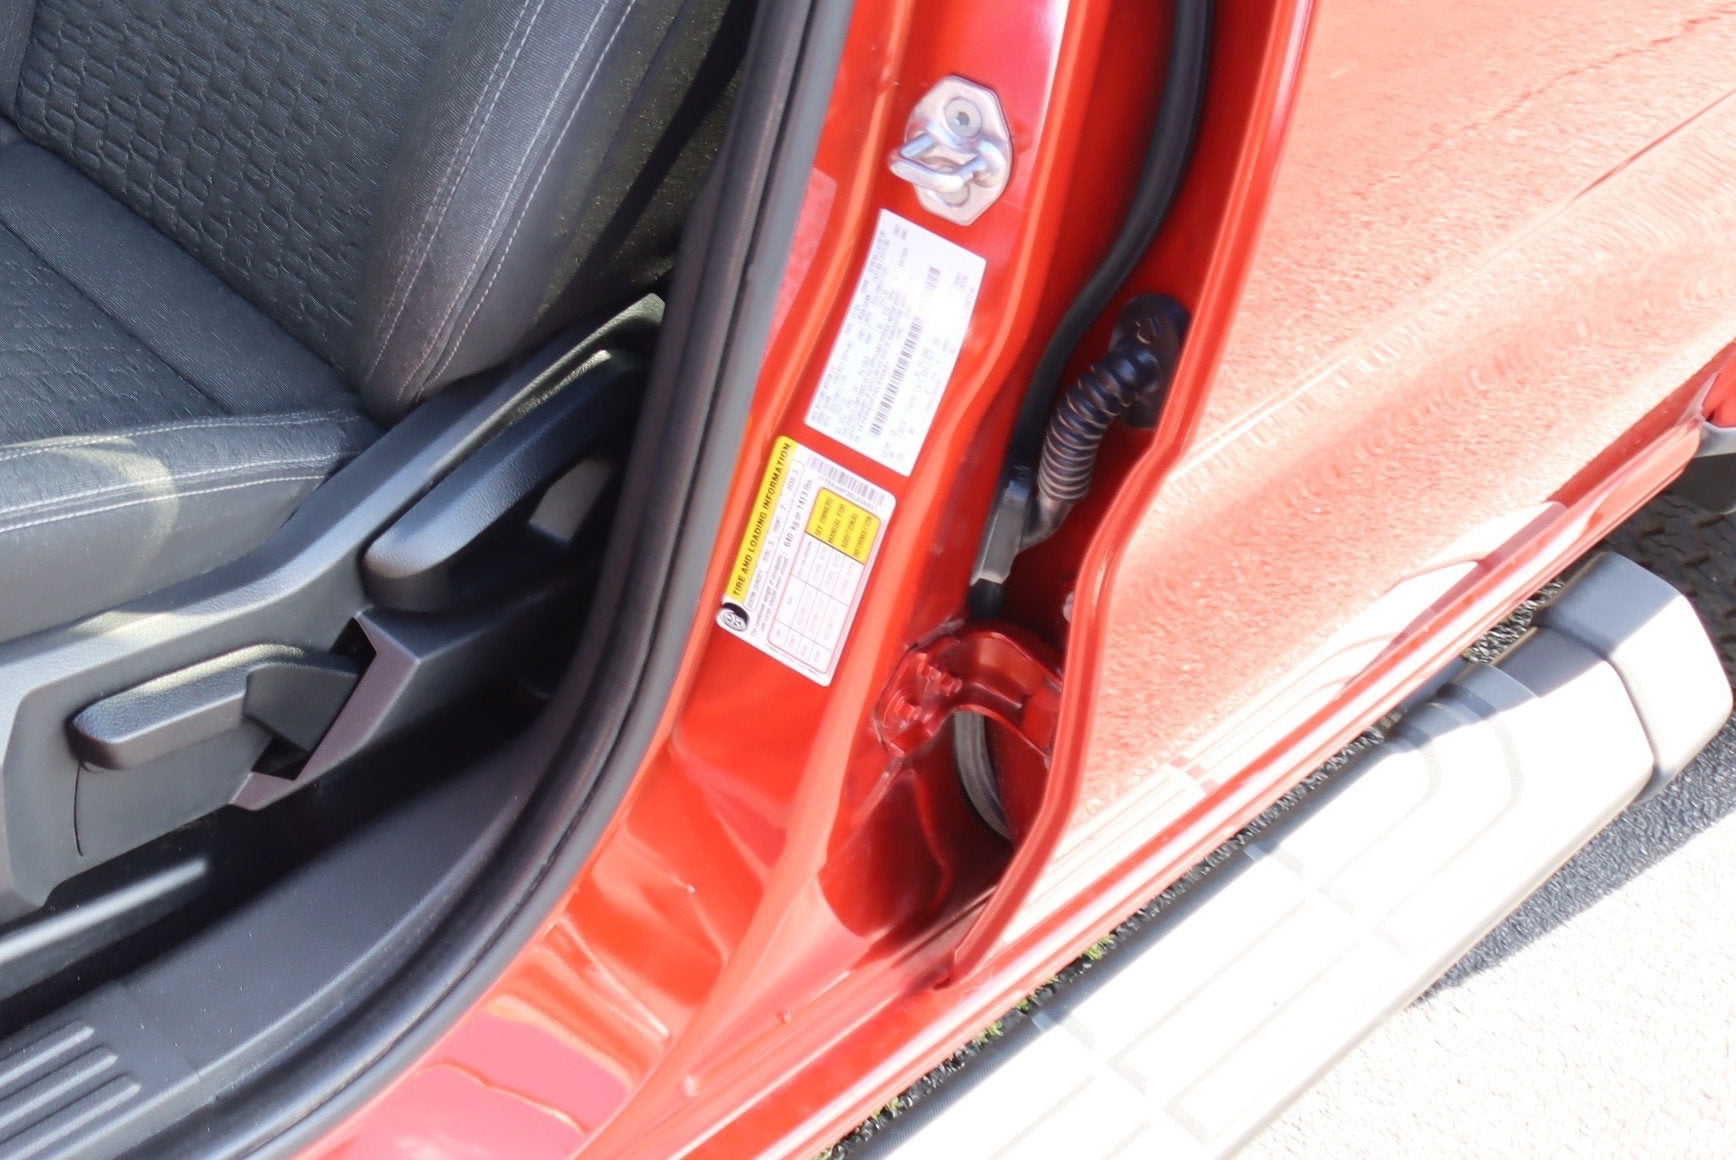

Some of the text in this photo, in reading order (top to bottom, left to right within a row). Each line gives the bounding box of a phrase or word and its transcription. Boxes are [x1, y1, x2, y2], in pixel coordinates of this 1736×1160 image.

[732, 441, 791, 597] TIRE AND LOADING INFORMATION
[783, 532, 794, 548] 640
[789, 520, 800, 531] kg
